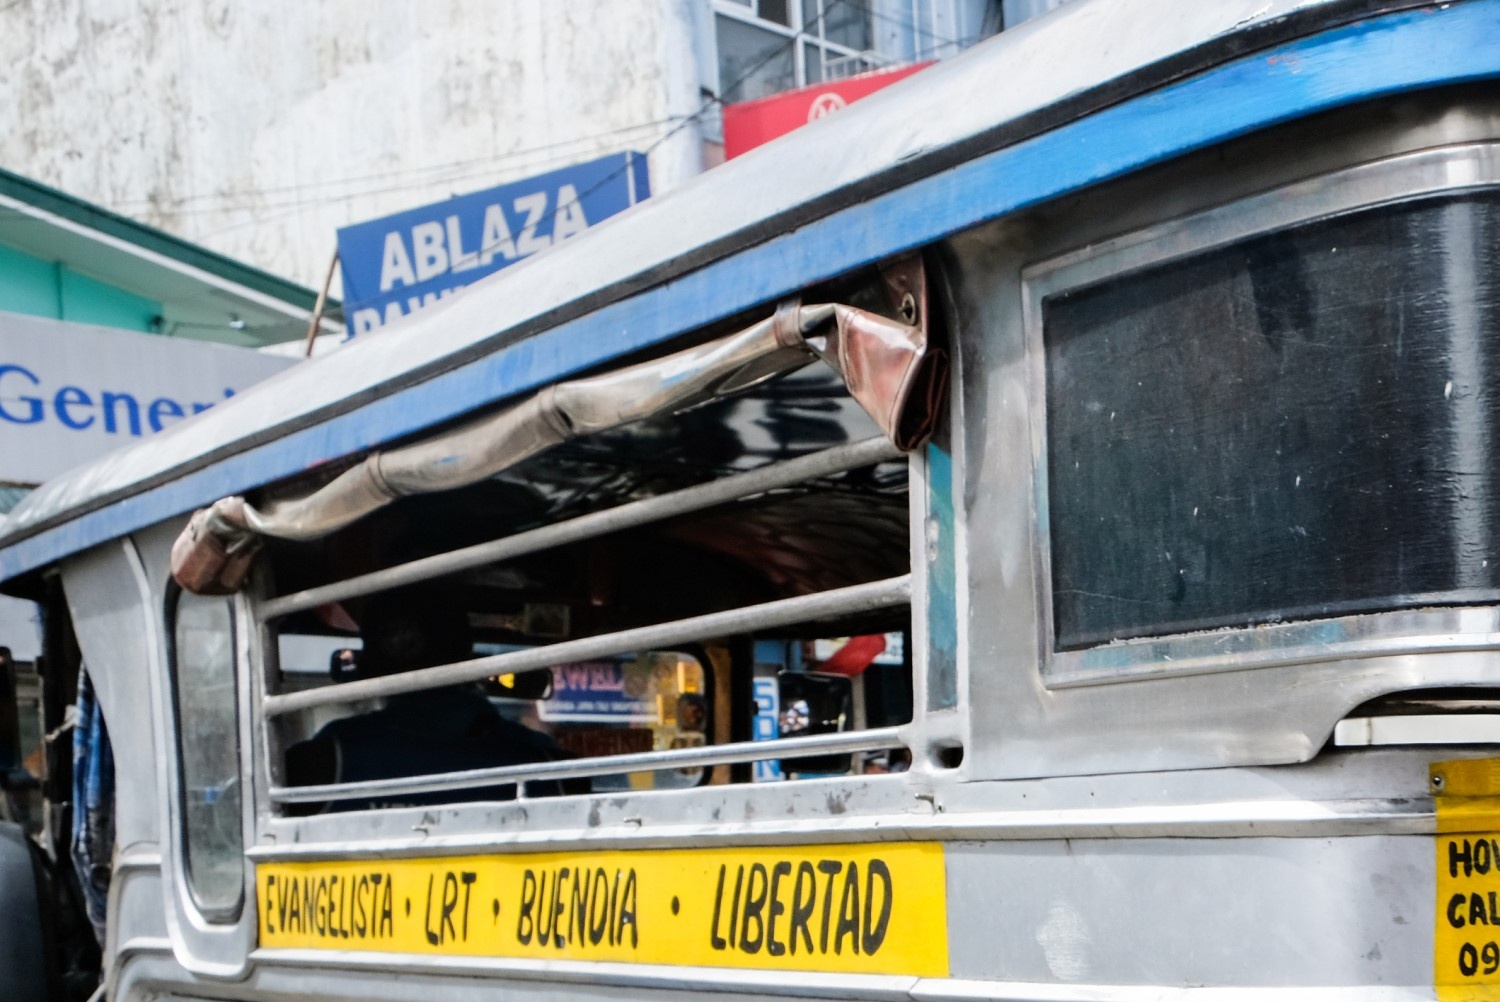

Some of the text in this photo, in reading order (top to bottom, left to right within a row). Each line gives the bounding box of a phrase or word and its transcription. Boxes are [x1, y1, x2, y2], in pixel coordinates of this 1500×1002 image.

[379, 183, 590, 293] ABLAZA
[266, 858, 893, 957] EVANGELISTA LRT BUENDIA LIBERTAD
